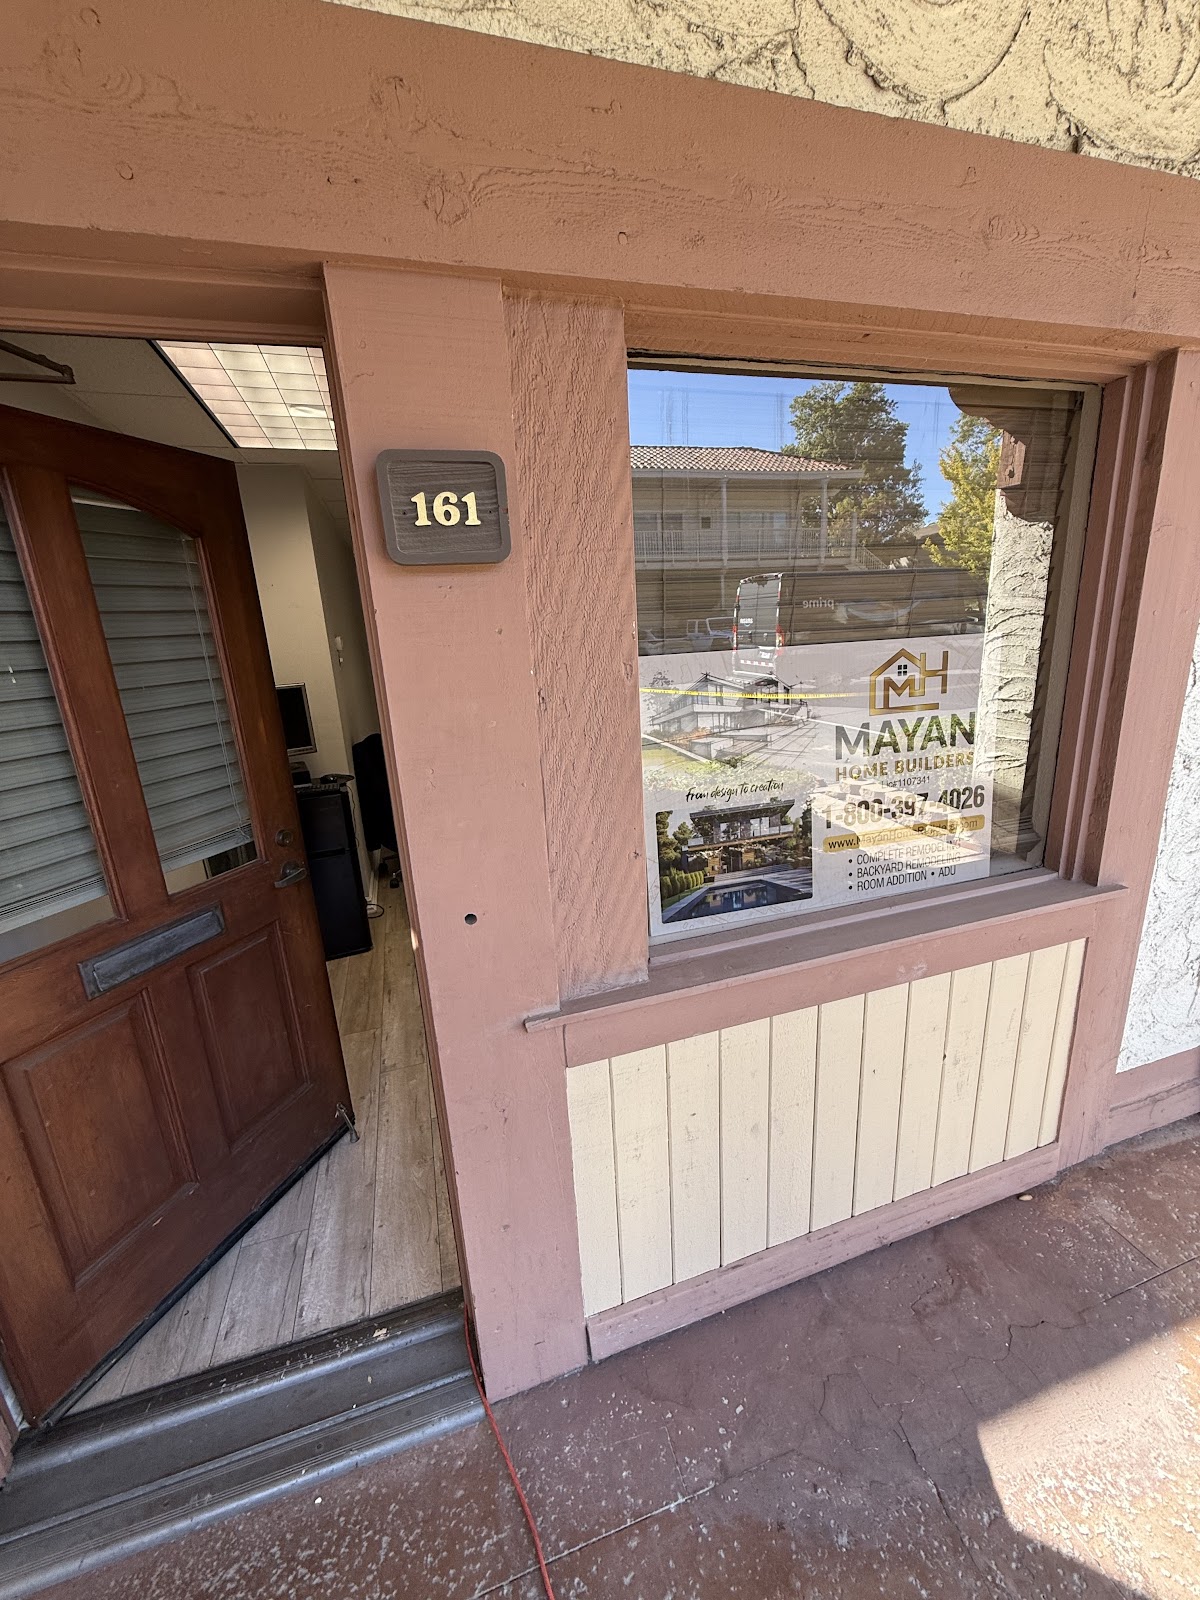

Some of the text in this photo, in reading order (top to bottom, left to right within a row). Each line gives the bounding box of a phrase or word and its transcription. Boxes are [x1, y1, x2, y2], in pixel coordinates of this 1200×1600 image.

[411, 491, 481, 526] 161
[835, 712, 976, 760] MAYAN
[836, 752, 974, 781] HOME BUILDERS
[710, 786, 737, 802] design
[750, 778, 784, 793] creation
[823, 784, 985, 829] 1-800-397-4026
[856, 839, 961, 865] COMPLETE REMODELING
[857, 851, 961, 878] BACKYARD REMODELING
[857, 866, 956, 891] ROOM ADDITION ADU
